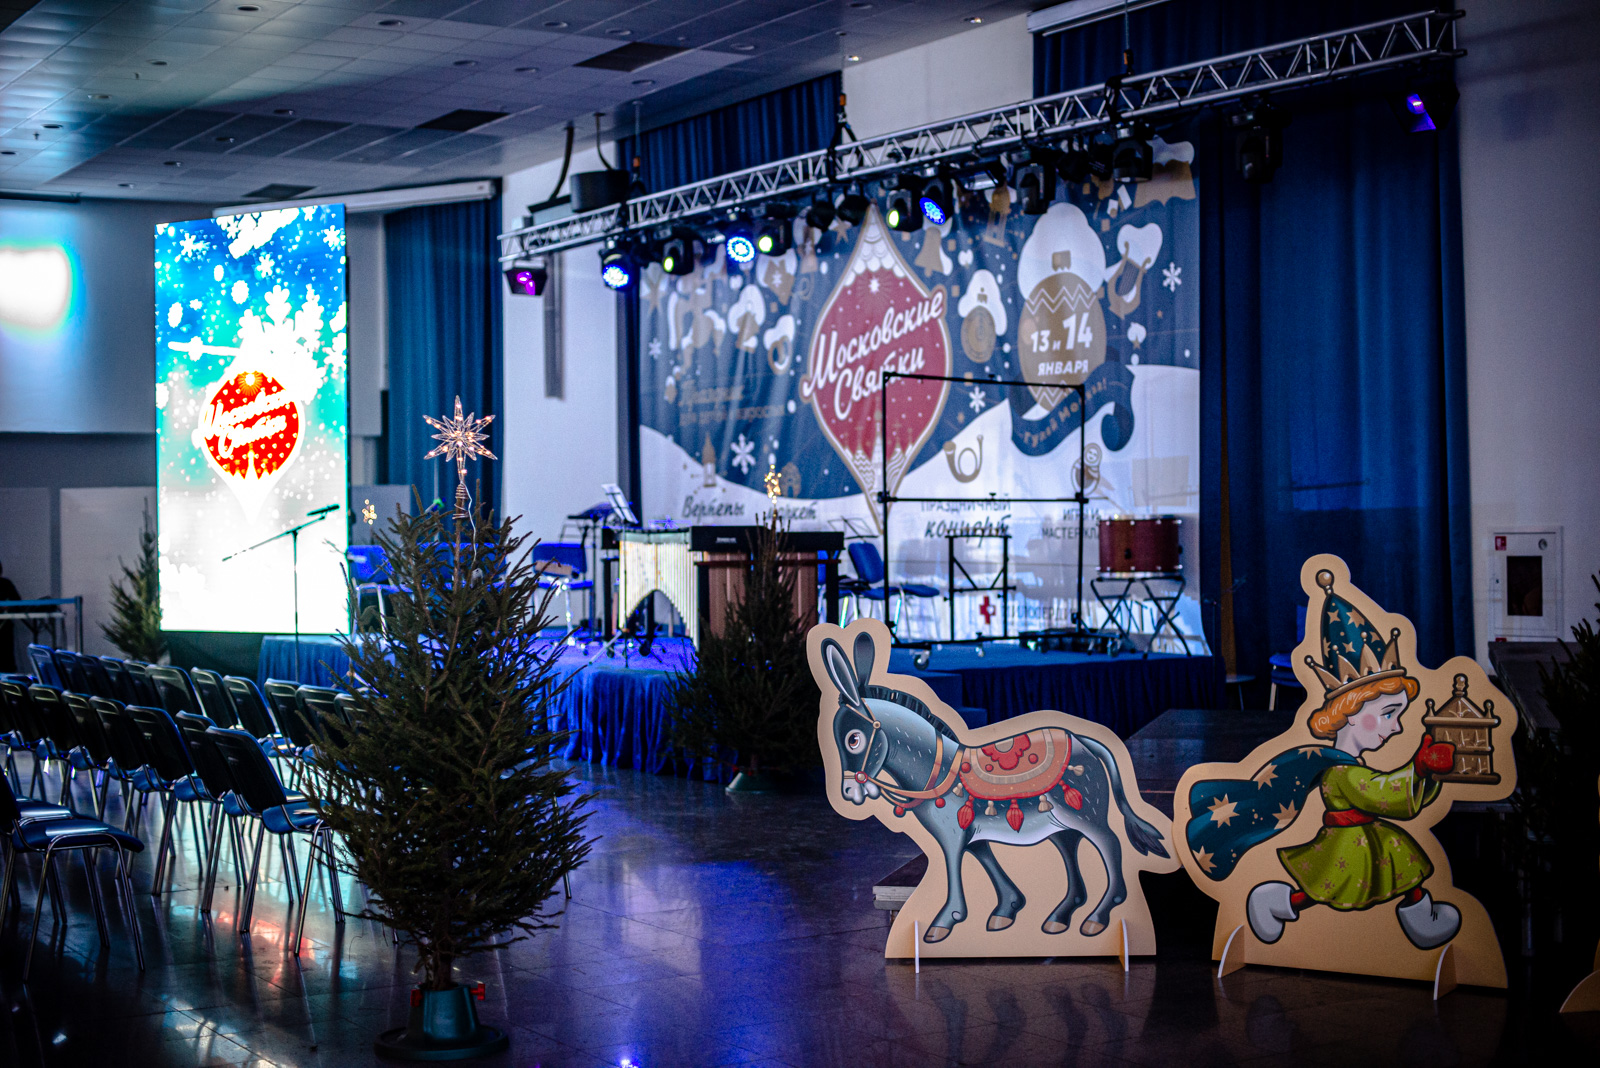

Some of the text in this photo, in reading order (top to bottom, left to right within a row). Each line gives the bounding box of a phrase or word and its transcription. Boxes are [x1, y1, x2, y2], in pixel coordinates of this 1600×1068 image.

[802, 291, 943, 397] Московские
[1031, 329, 1051, 353] 13
[1062, 311, 1094, 350] 14
[834, 346, 926, 420] Святки
[1037, 359, 1089, 377] ЯНВАРЯ
